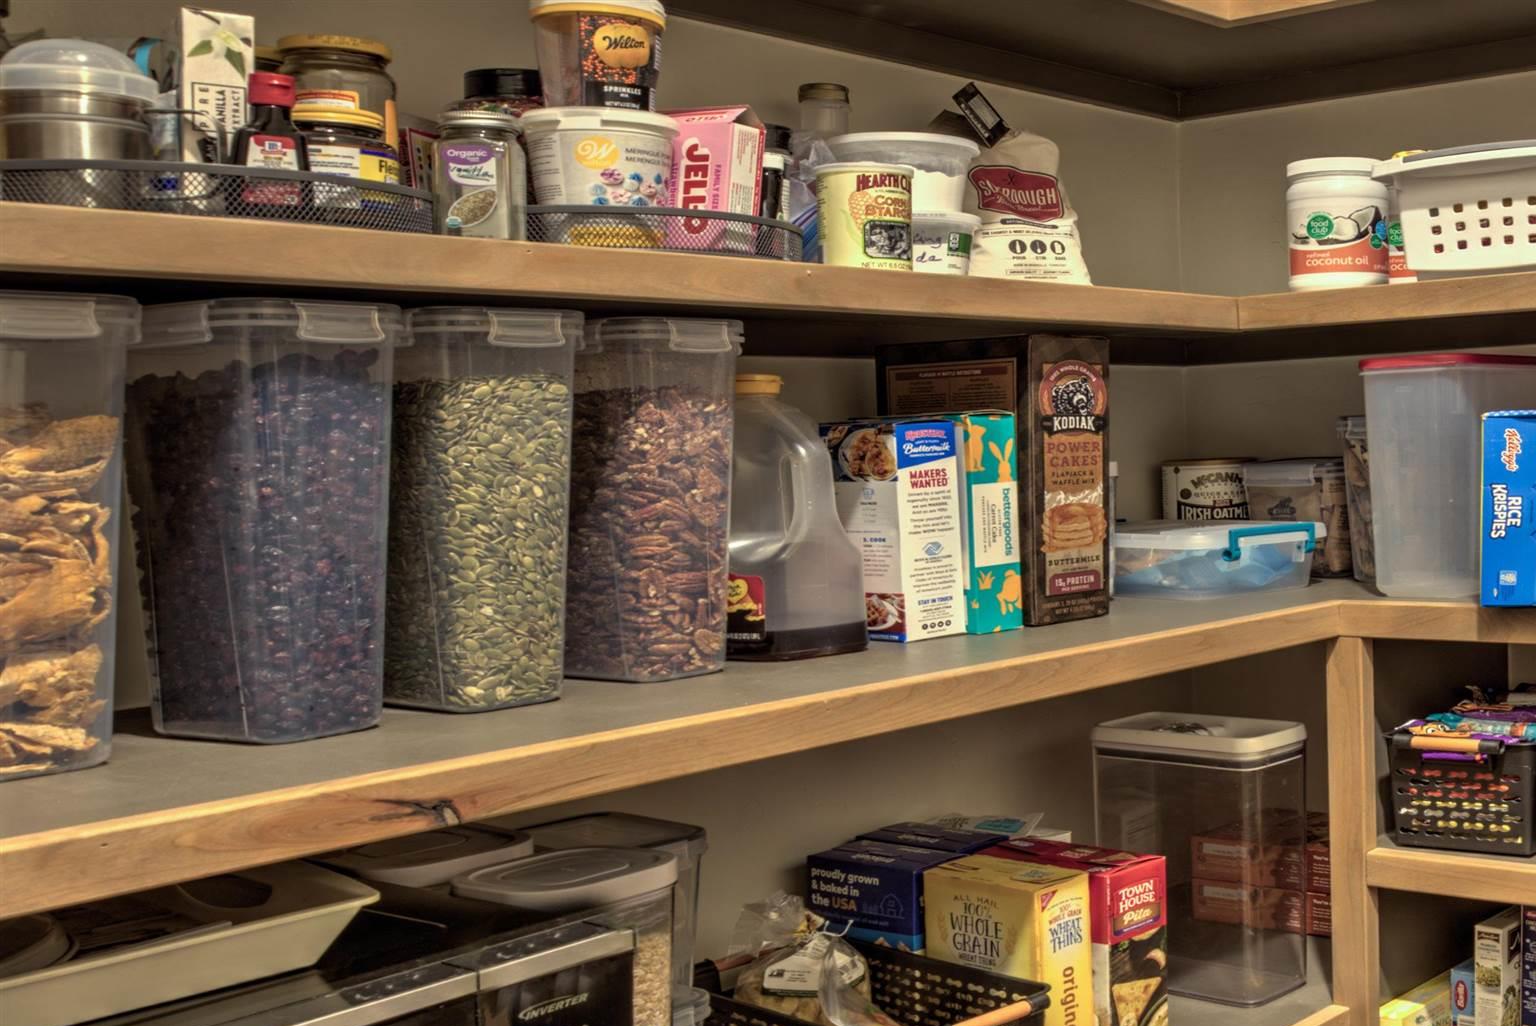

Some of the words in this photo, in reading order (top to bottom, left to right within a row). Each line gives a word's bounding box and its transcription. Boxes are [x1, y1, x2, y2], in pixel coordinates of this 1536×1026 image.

[602, 35, 645, 50] Wilton
[603, 84, 641, 95] SPRINKLES
[856, 174, 897, 191] HEARTH
[1311, 220, 1329, 228] food
[1311, 227, 1328, 235] club
[1305, 256, 1353, 266] coconut
[1355, 255, 1368, 265] oil
[1053, 416, 1096, 431] KODIAK
[1047, 441, 1101, 453] POWER
[1503, 428, 1521, 472] Kellogg's
[1049, 455, 1098, 468] CAKES
[909, 468, 947, 479] MAKERS
[910, 478, 948, 489] WANTED
[1181, 504, 1211, 520] IRISH
[1490, 484, 1508, 539] KRISPIES
[1507, 496, 1522, 527] RICE
[1002, 488, 1013, 556] bettergoods
[1048, 554, 1100, 566] BUTTERMILK
[811, 867, 846, 883] proudly
[848, 874, 880, 886] grown
[811, 880, 818, 889] &
[820, 882, 848, 896] baked
[850, 886, 860, 897] in
[1118, 879, 1155, 901] TOWN
[811, 894, 830, 907] the
[832, 897, 857, 911] USA
[963, 902, 992, 918] 100%
[1119, 892, 1156, 914] HOUSE
[1123, 908, 1152, 924] Pita
[950, 912, 1004, 940] WHOLE
[1048, 917, 1083, 937] WHEAT
[952, 932, 1000, 958] GRAIN
[1050, 931, 1083, 953] THINS
[525, 993, 590, 1021] INVERTER
